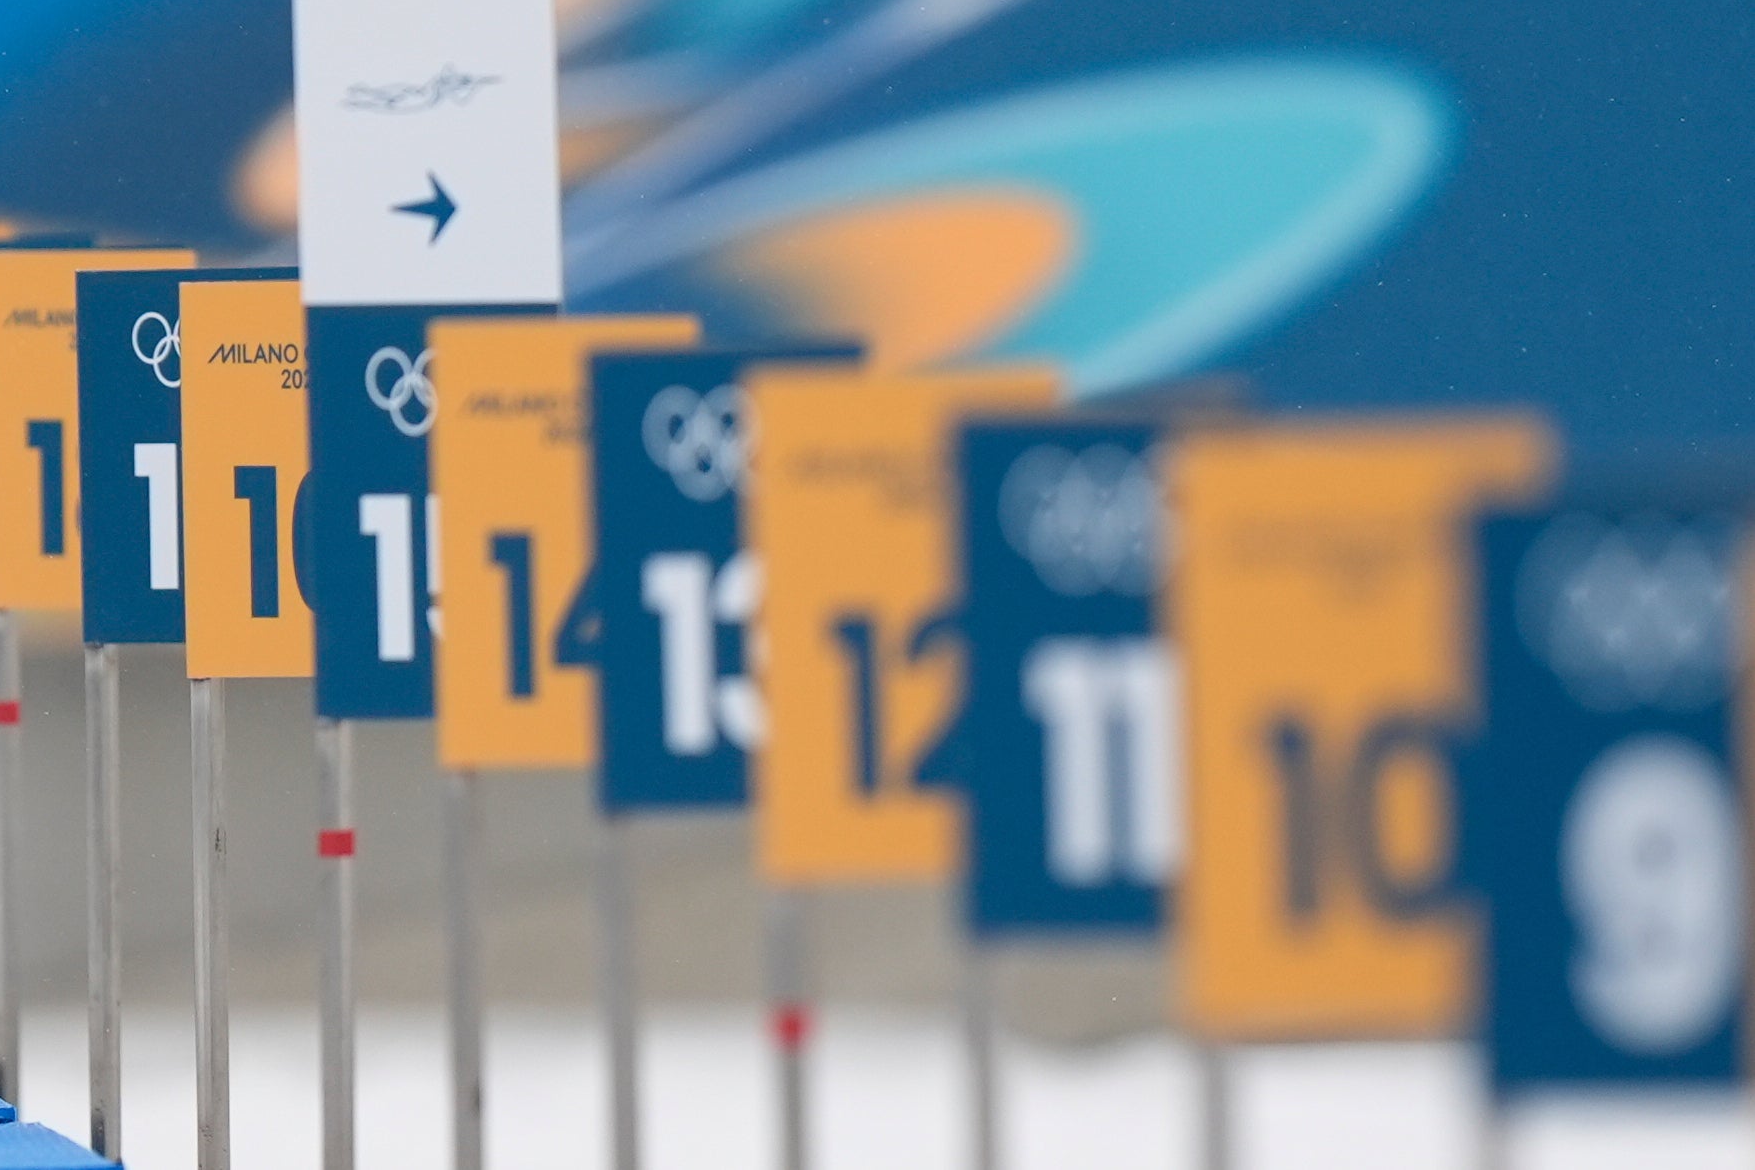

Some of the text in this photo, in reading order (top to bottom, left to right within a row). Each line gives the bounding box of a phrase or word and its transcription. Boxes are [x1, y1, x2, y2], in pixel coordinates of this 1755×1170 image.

[3, 307, 76, 327] MILAN
[207, 343, 299, 363] MILANO
[281, 368, 309, 389] 20
[27, 420, 64, 555] 1
[134, 442, 180, 590] 1
[1020, 638, 1184, 885] 11
[1559, 730, 1740, 1056] 9
